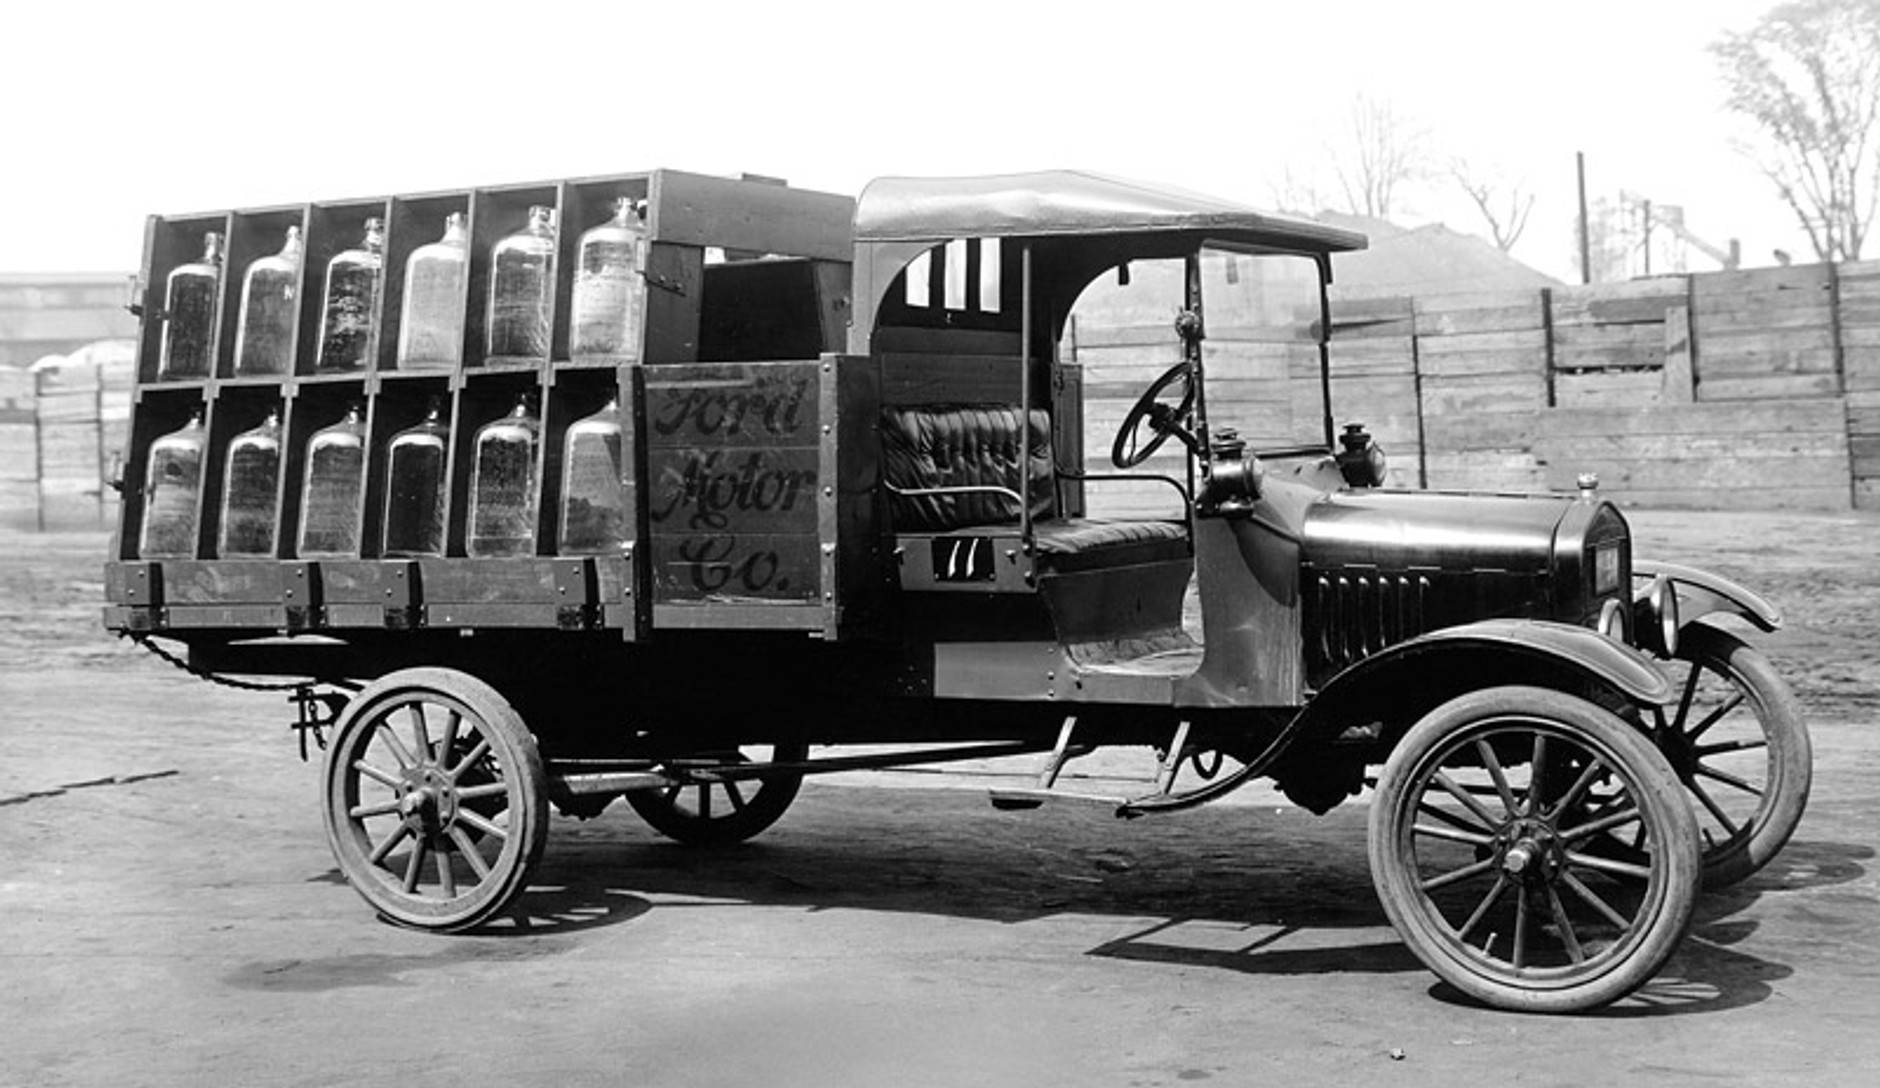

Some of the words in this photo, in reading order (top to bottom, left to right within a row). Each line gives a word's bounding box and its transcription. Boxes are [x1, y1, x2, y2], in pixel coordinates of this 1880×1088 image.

[655, 378, 807, 435] Ford
[651, 451, 817, 529] Motor
[680, 536, 789, 591] Co.
